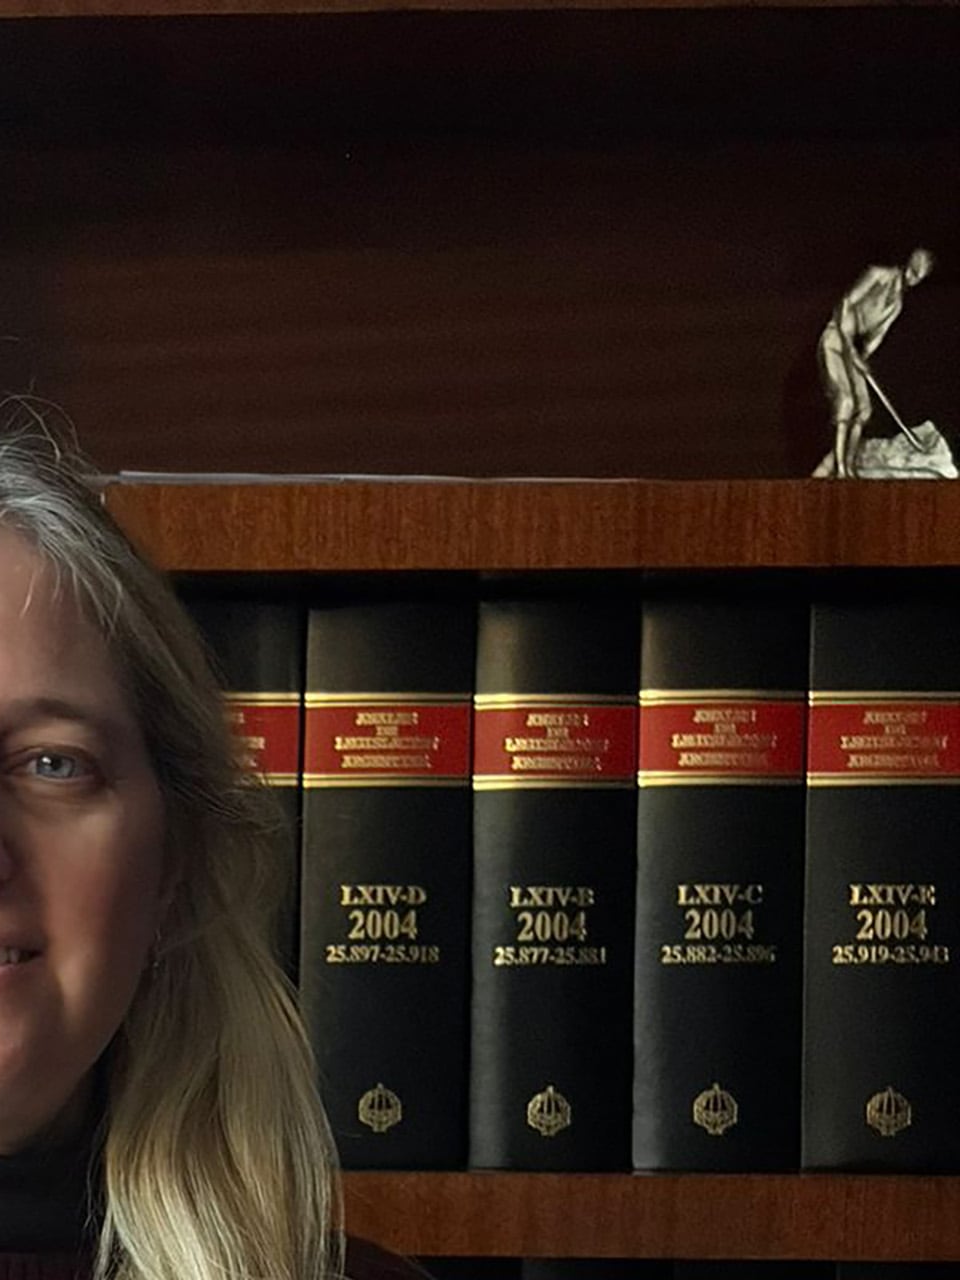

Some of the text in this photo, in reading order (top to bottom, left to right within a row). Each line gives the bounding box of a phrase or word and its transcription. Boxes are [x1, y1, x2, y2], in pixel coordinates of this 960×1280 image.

[340, 885, 427, 906] LXIV-D
[677, 884, 763, 906] LXIV-C
[348, 909, 418, 940] 2004
[517, 911, 588, 941] 2004
[684, 909, 755, 940] 2004
[856, 909, 928, 940] 2004
